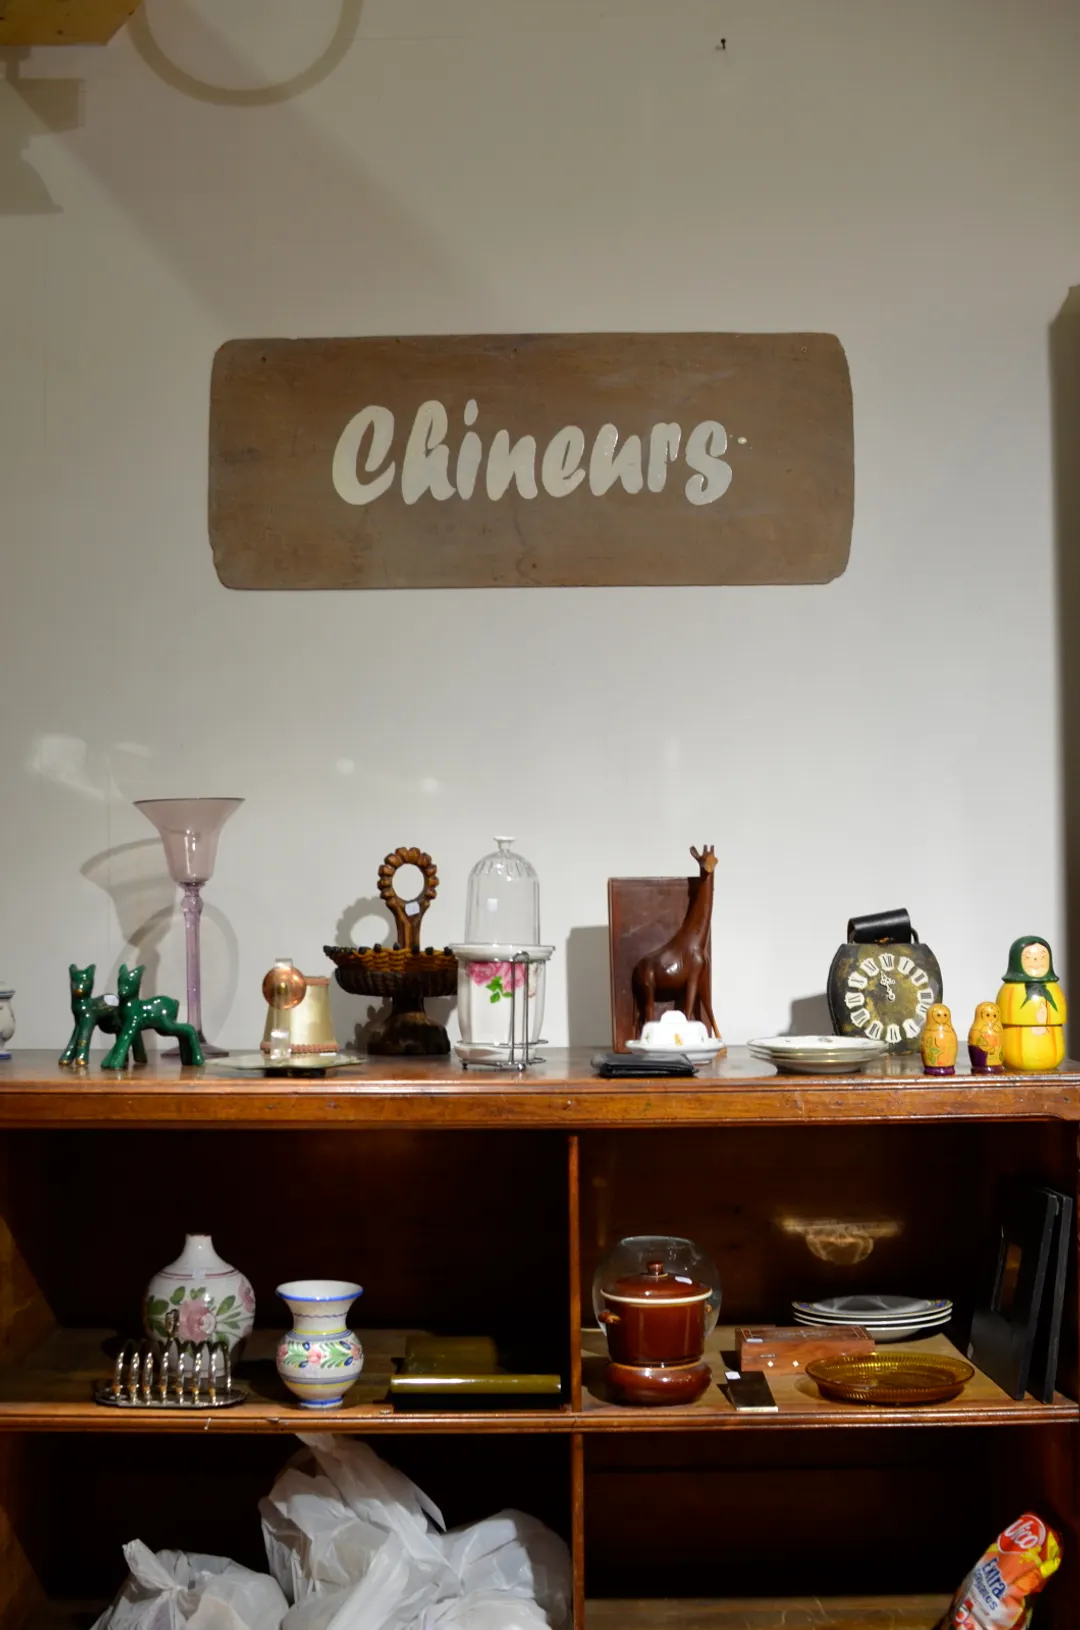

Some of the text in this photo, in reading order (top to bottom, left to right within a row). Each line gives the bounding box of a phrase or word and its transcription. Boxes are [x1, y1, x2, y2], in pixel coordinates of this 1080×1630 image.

[332, 399, 733, 506] Chineurs
[1004, 1519, 1038, 1549] Vico
[982, 1557, 1006, 1600] Extra
